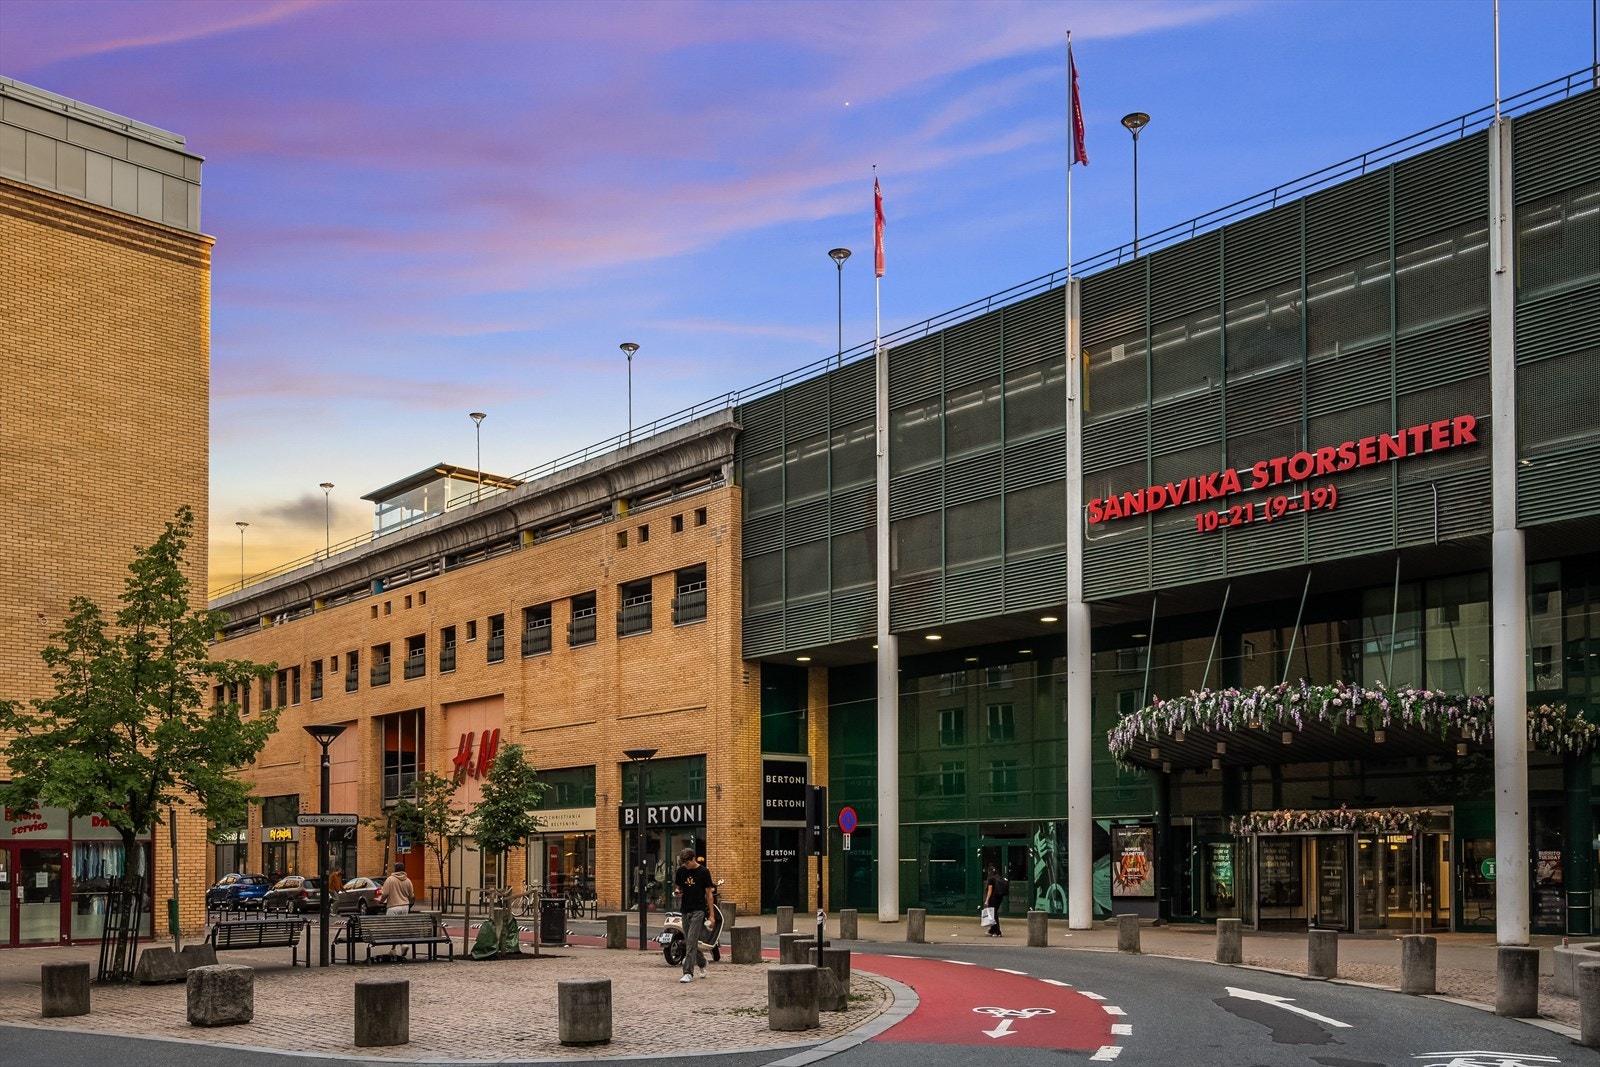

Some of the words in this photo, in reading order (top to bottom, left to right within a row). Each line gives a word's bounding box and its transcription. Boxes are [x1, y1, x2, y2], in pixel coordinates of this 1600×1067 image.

[1088, 468, 1242, 525] SANDVIKA
[1252, 414, 1478, 490] STORSENTER
[1195, 502, 1255, 533] 10-21
[1264, 483, 1338, 522] (9-19)
[453, 728, 501, 785] H&M
[765, 775, 805, 784] BERTONI
[766, 799, 805, 808] BERTONI
[11, 821, 48, 835] service
